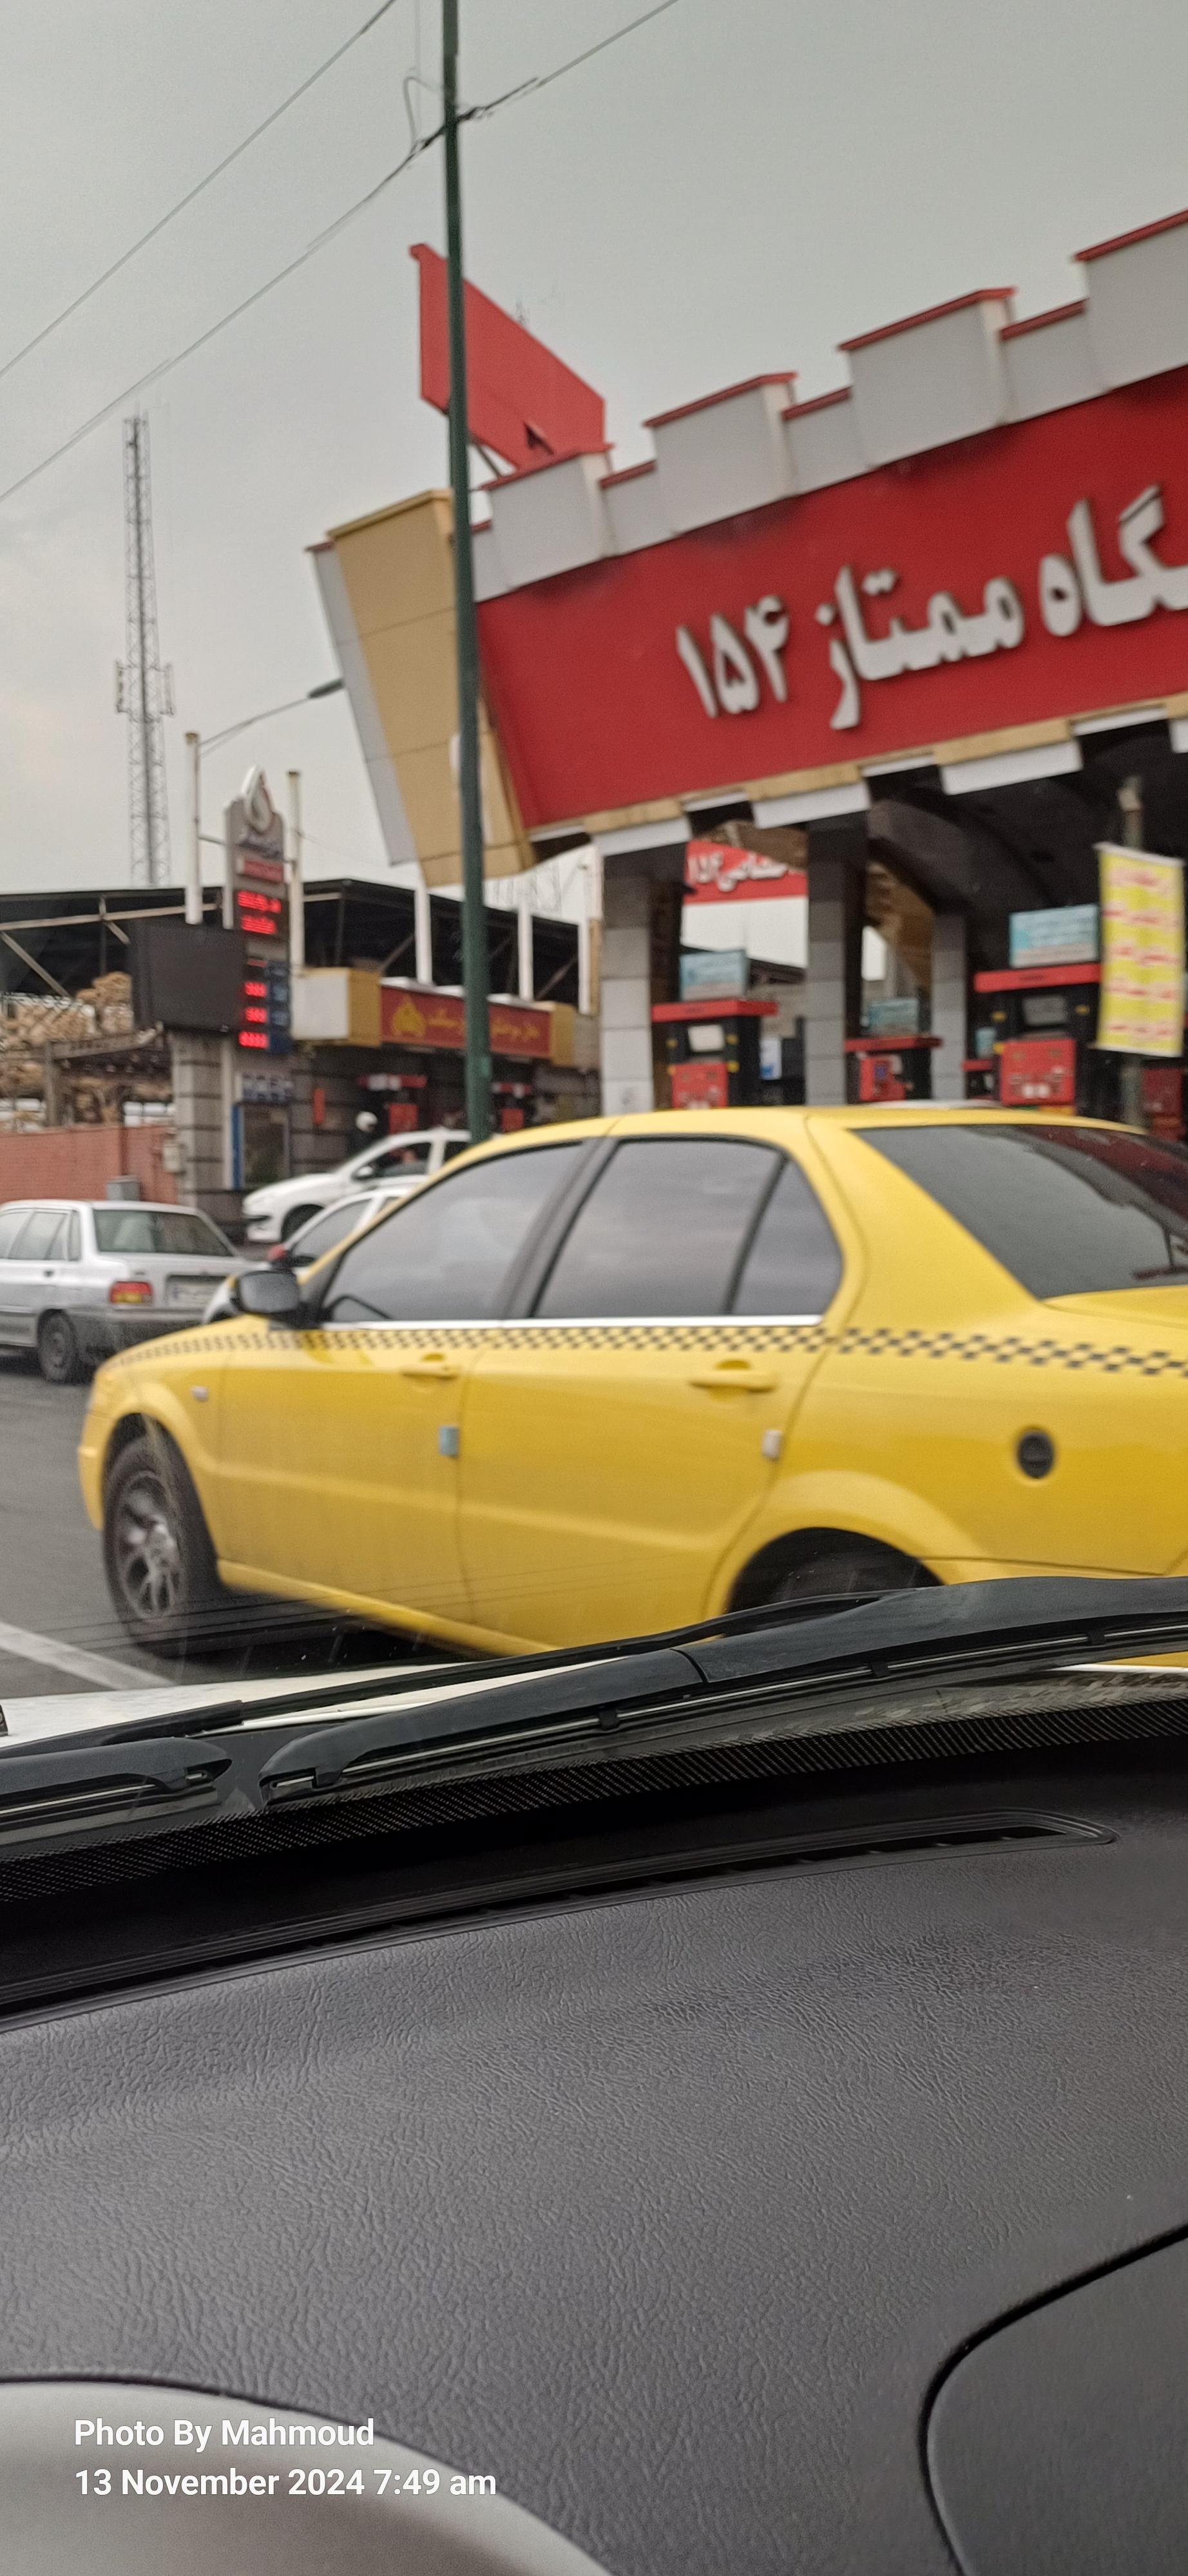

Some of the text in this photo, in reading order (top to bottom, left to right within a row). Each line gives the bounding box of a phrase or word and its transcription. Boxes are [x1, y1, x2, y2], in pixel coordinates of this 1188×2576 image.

[676, 485, 1188, 730] گاه ممتاز ۱۵۴
